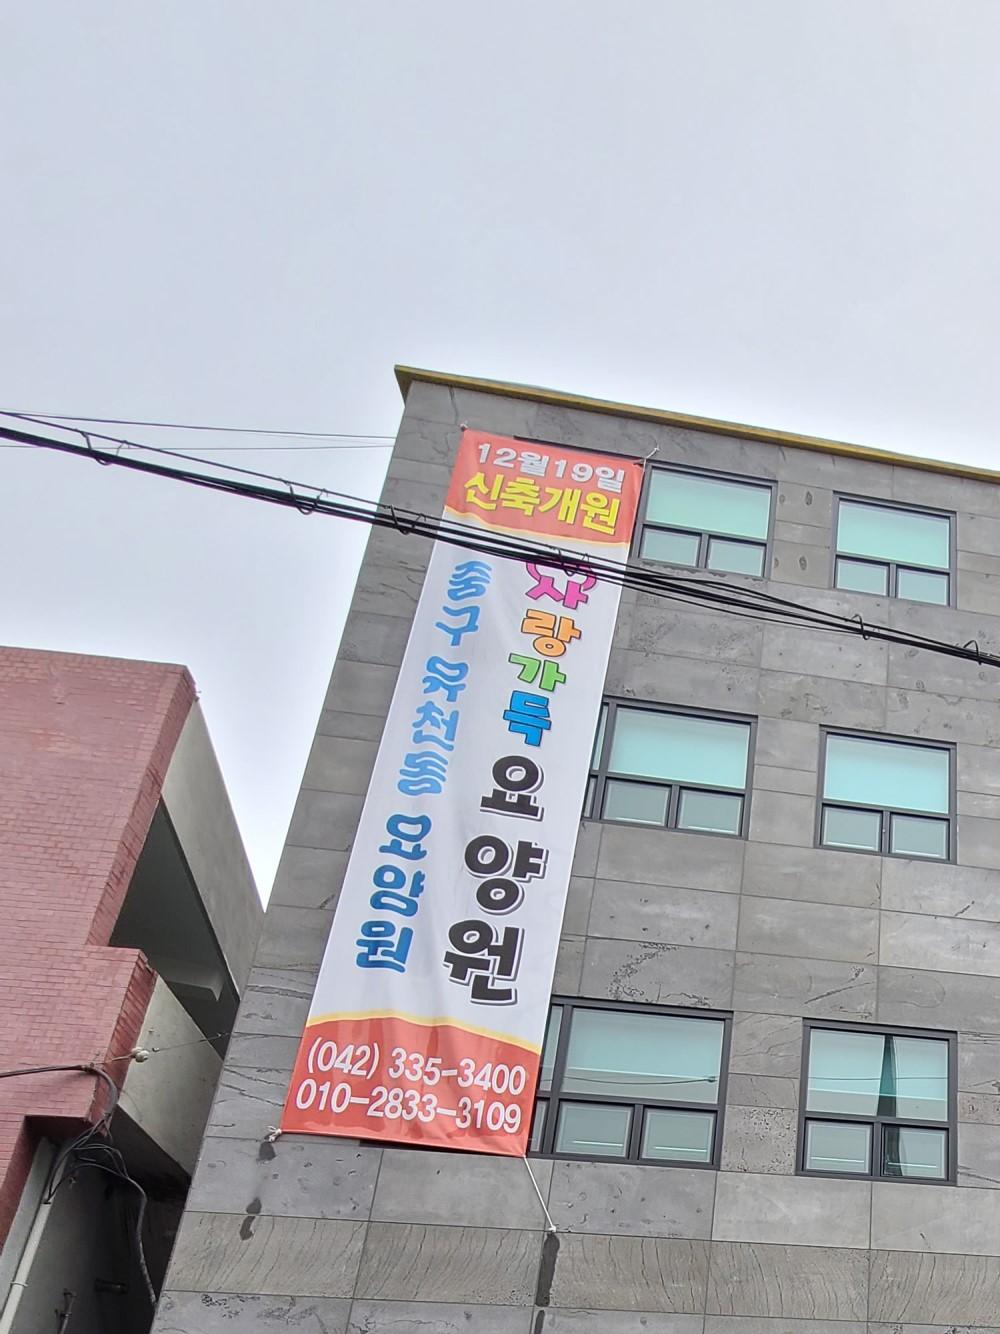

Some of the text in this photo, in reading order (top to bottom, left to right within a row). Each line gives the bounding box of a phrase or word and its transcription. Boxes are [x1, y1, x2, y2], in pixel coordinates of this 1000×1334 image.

[464, 471, 620, 535] 신축개원
[355, 560, 492, 973] 중구 유천동 요양원
[443, 558, 597, 1005] 사랑가득 요양원
[307, 1037, 527, 1096] (042) 335-3400
[295, 1079, 521, 1134] 010-2833-3109
